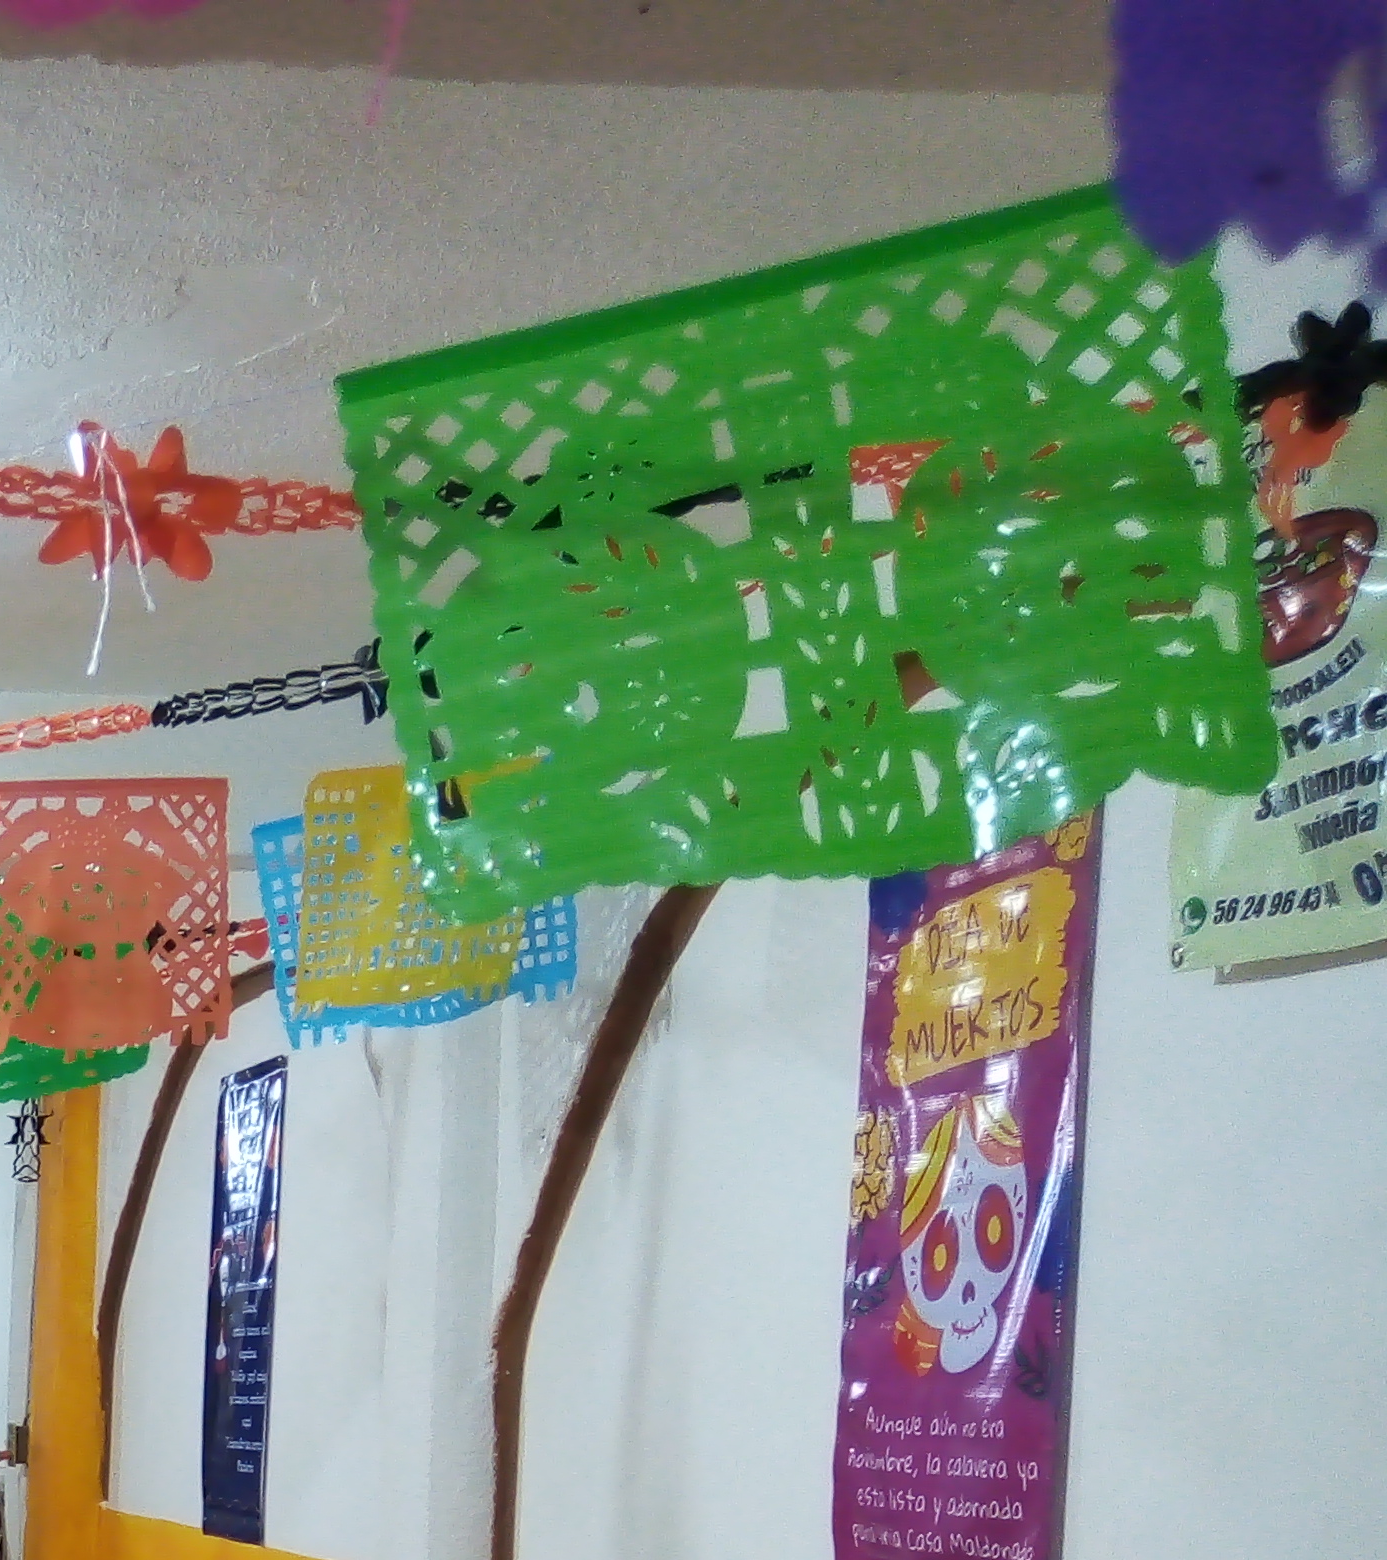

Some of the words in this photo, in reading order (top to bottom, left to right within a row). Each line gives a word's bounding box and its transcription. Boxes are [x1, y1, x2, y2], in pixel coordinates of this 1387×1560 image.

[904, 976, 1046, 1071] MUERTOS
[865, 1405, 923, 1441] Aunque
[981, 1419, 1005, 1440] era
[926, 1452, 941, 1476] la
[946, 1455, 1008, 1480] calavera
[1017, 1460, 1039, 1491] ya
[888, 1487, 926, 1513] lista
[933, 1496, 942, 1526] y
[946, 1493, 1024, 1521] adornada
[907, 1527, 943, 1554] Casa
